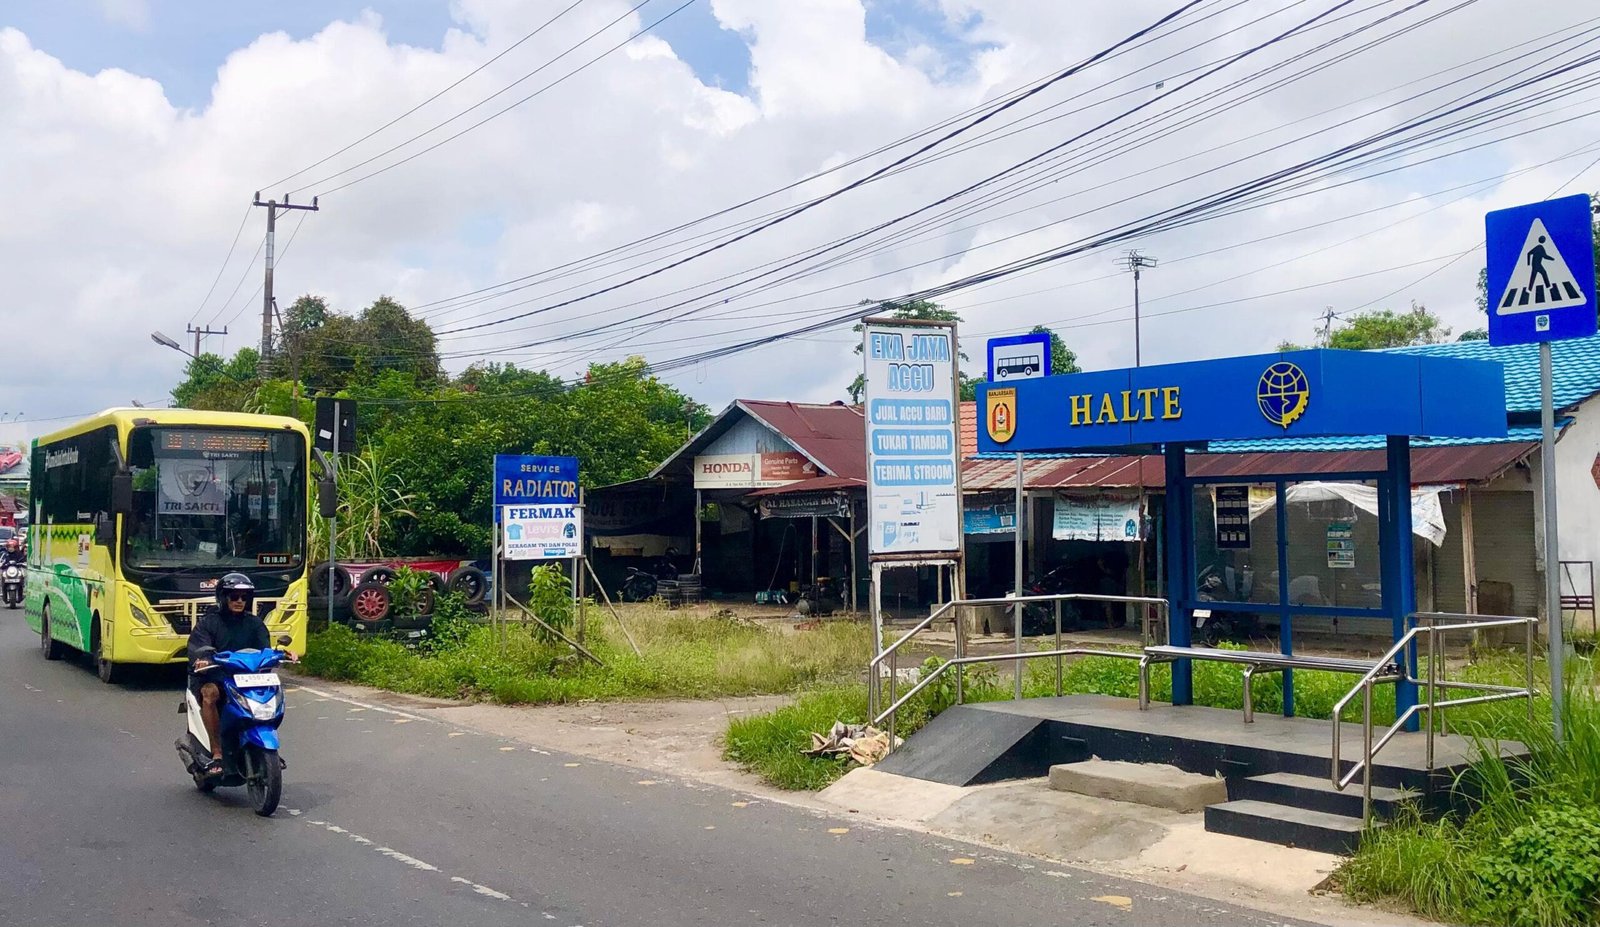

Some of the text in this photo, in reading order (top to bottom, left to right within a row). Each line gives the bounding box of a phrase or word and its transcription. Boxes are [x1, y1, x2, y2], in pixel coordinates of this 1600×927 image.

[870, 332, 950, 362] EKA JAYA
[888, 363, 934, 391] ACCU
[876, 406, 947, 420] JUAL ACCU BARU
[1069, 386, 1183, 425] HALTE
[877, 435, 948, 450] TUKAR TAMBAH
[520, 464, 560, 473] SERVICE
[703, 462, 751, 474] HONDA
[876, 464, 952, 480] TERIMA STROOM
[503, 479, 576, 498] RADIATOR
[164, 502, 220, 511] TRI SAKTI
[509, 508, 576, 519] FERMAK
